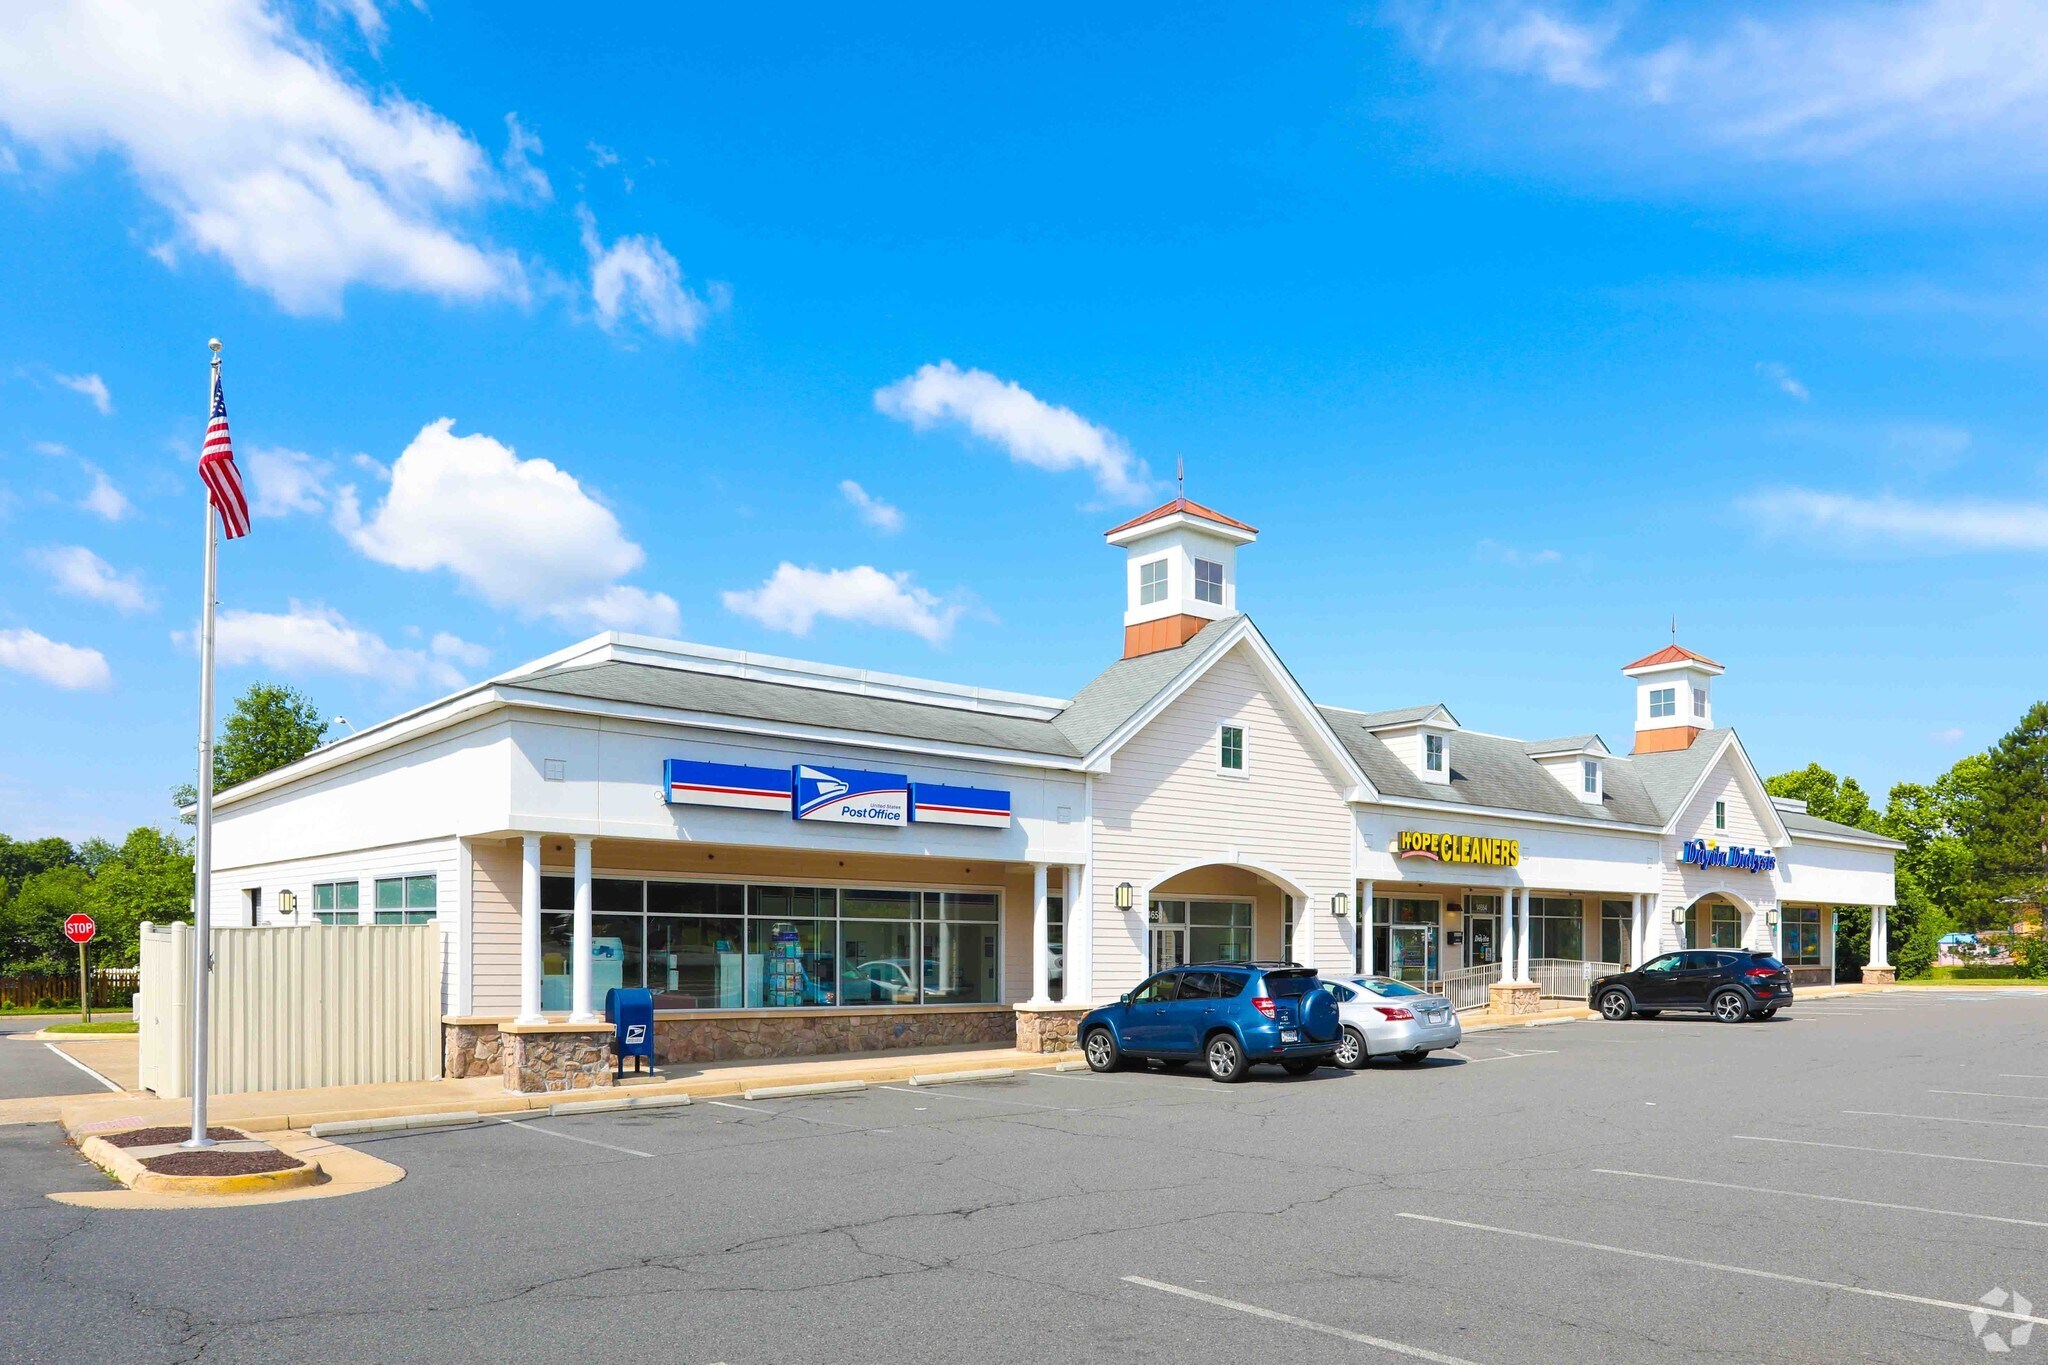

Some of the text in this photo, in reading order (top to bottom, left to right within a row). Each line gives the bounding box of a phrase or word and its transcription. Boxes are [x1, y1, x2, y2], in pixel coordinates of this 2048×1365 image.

[841, 806, 901, 821] Post Office
[1398, 831, 1519, 867] HOPE CLEANERS
[67, 922, 92, 934] STOP
